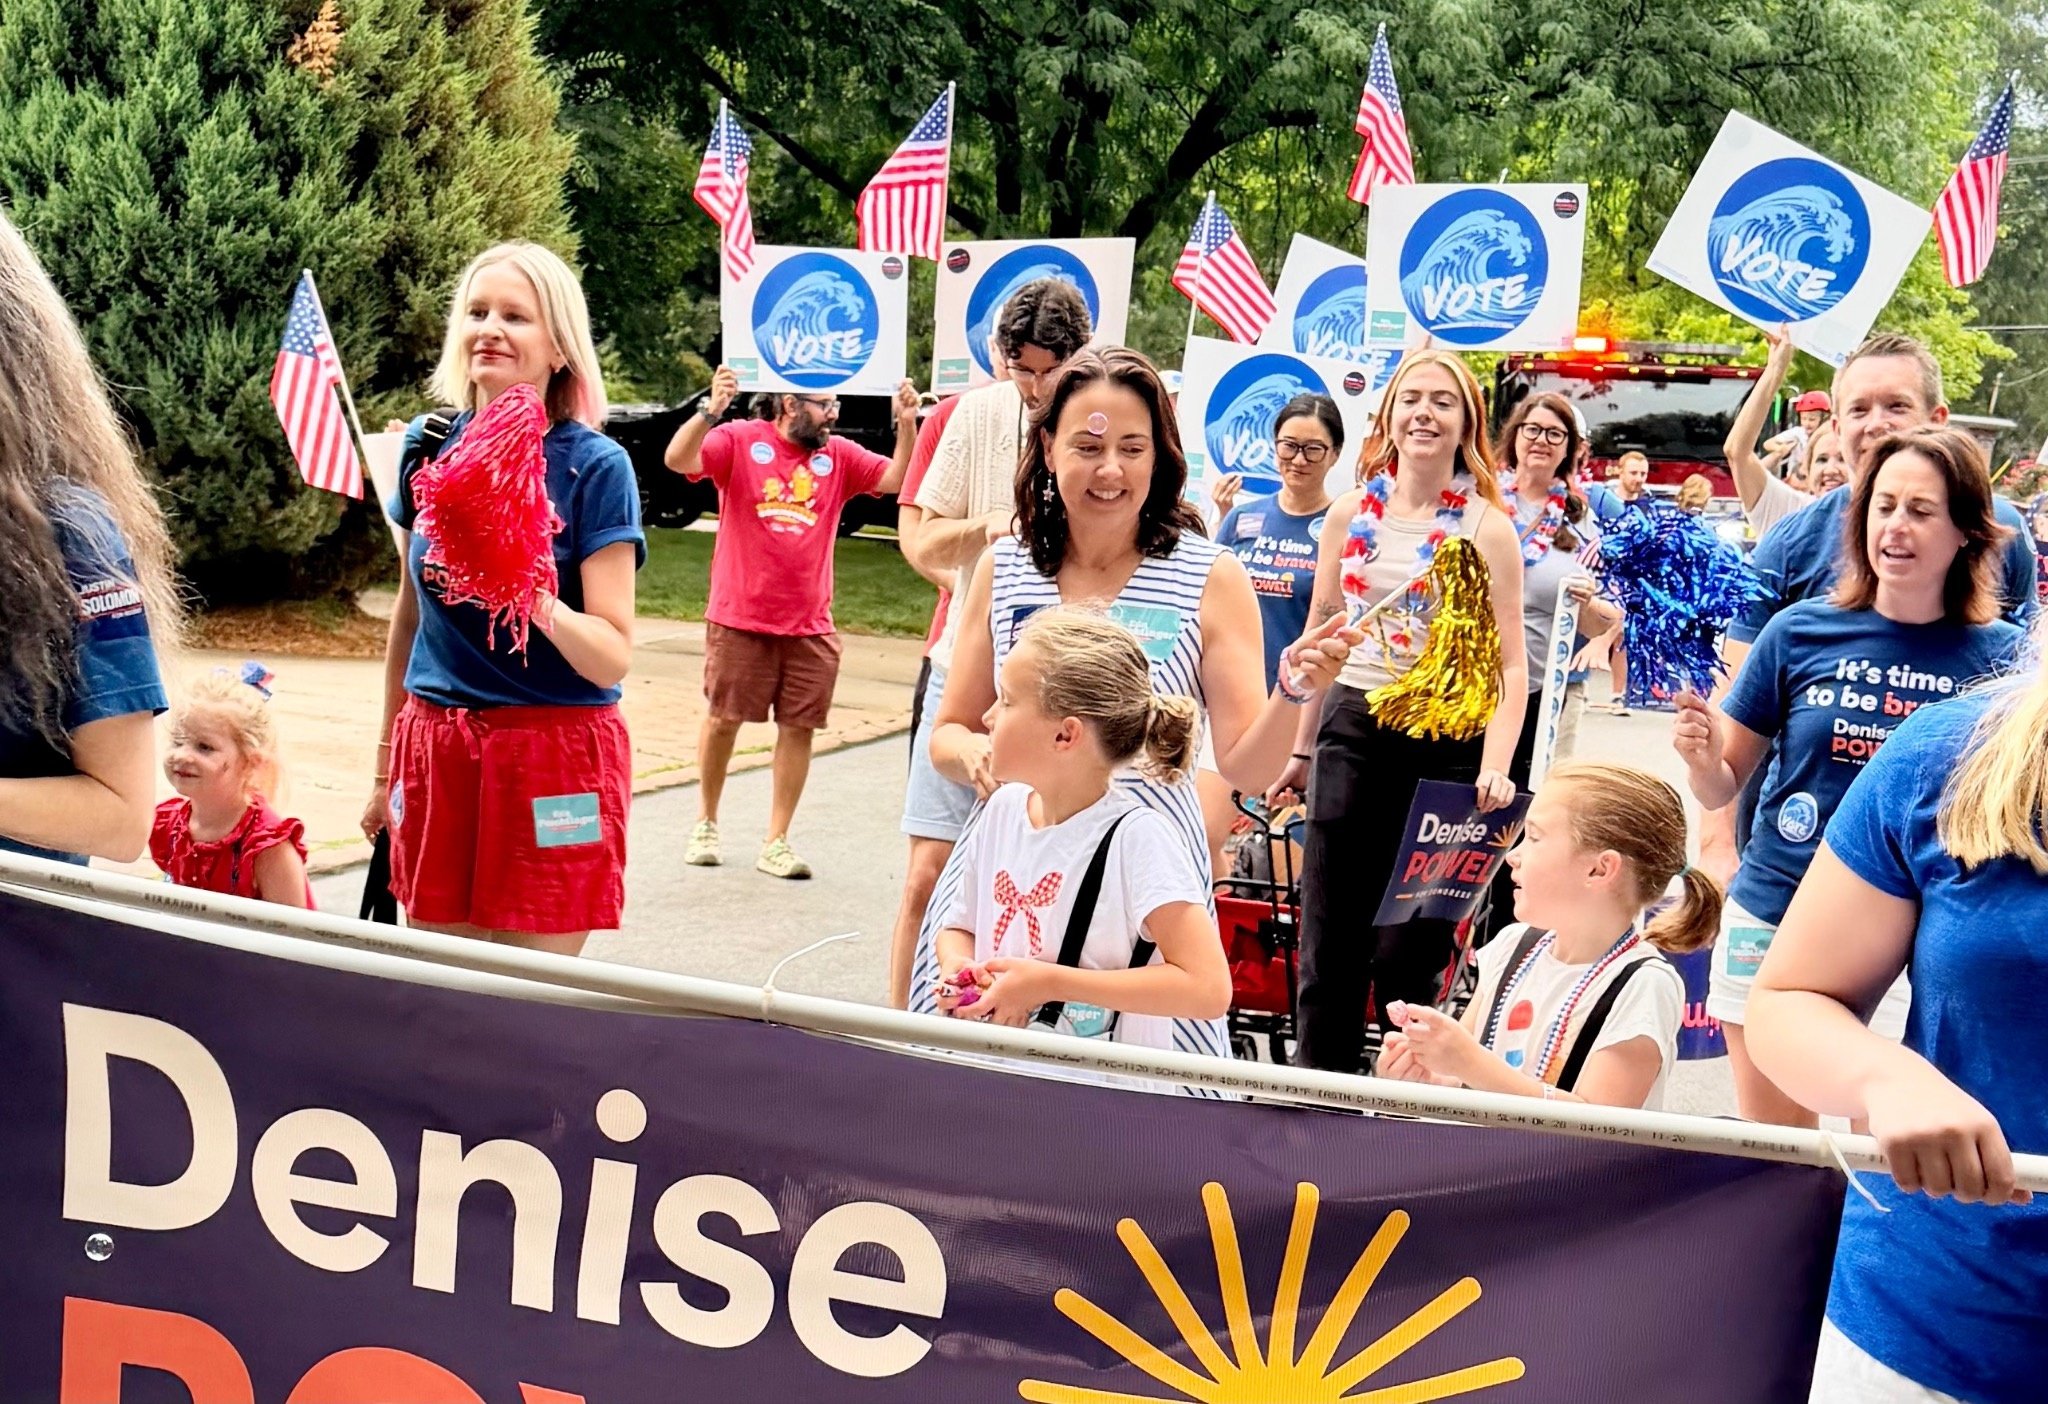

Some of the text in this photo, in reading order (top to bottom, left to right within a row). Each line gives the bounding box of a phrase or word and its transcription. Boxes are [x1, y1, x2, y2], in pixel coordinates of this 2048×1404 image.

[1720, 234, 1837, 300] VOTE
[1422, 273, 1529, 321] VOTE
[773, 327, 864, 367] VOTE
[1223, 427, 1270, 468] VO
[81, 588, 141, 616] SOLOMON
[1835, 658, 1953, 693] It's time
[1805, 684, 1919, 717] to be br
[1416, 812, 1488, 845] Denise
[1403, 850, 1496, 885] POWEL
[62, 1002, 947, 1378] Denise
